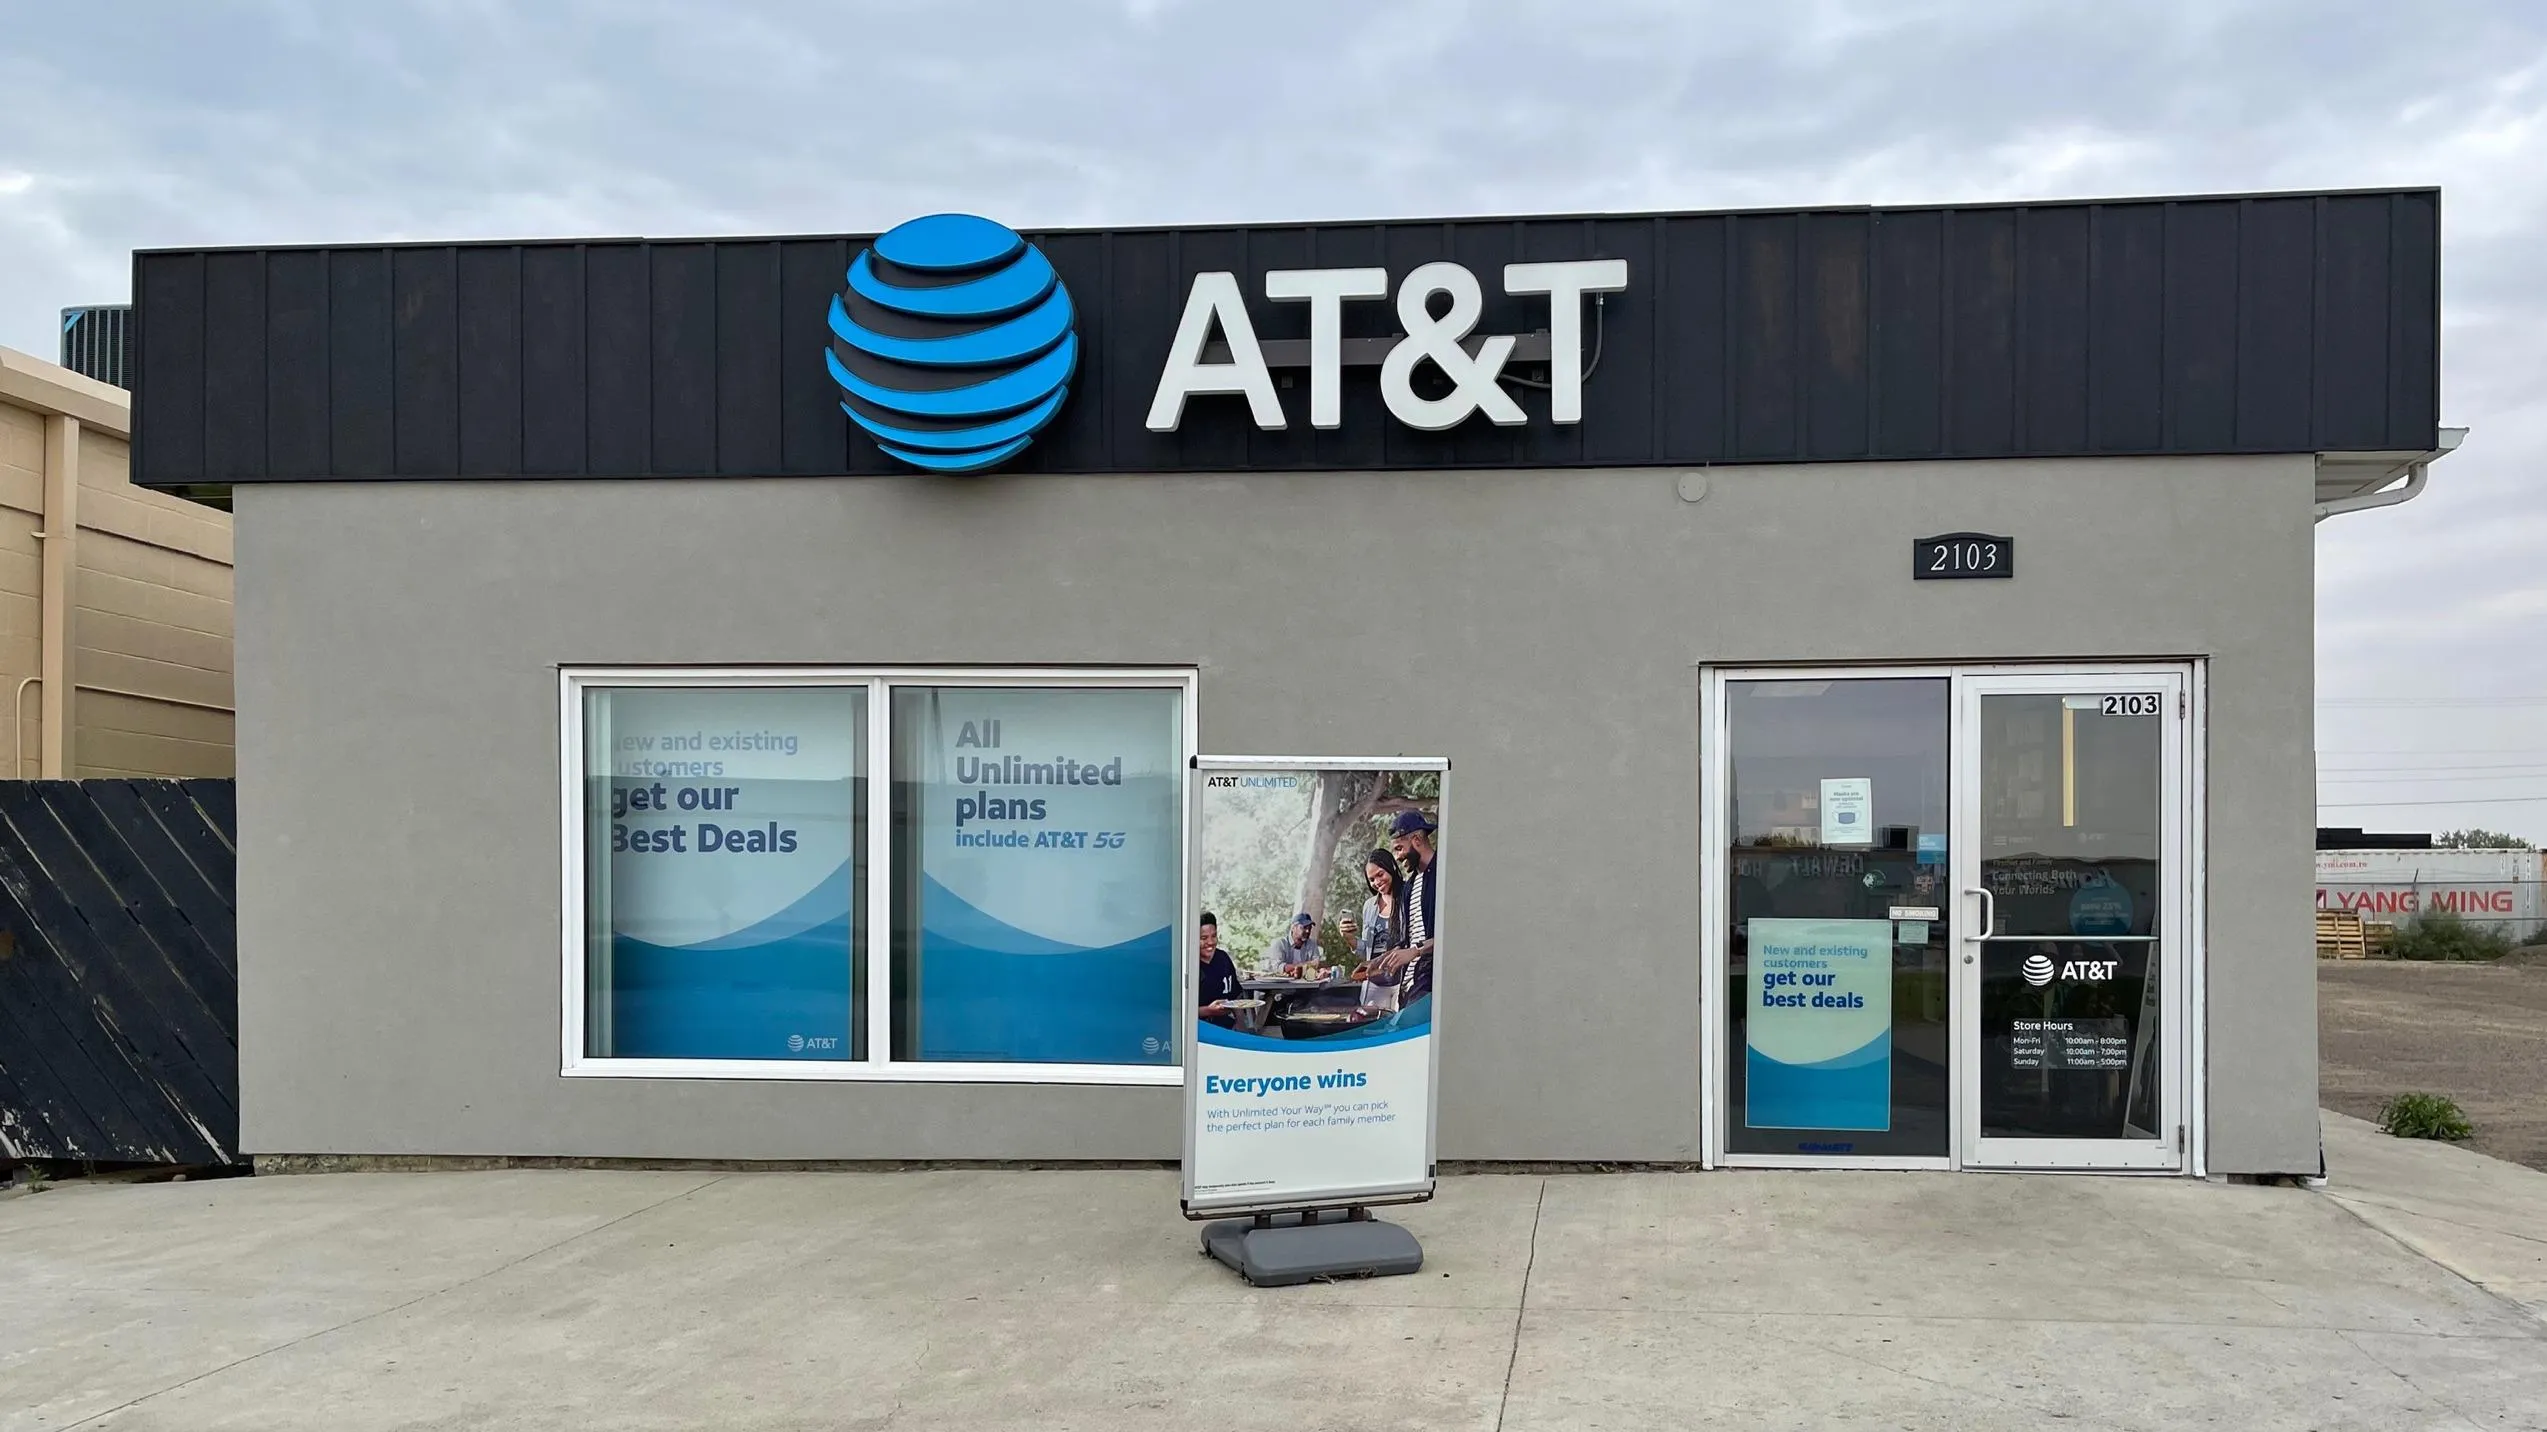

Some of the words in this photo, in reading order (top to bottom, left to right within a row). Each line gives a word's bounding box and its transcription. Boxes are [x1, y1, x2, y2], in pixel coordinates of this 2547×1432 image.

[1145, 259, 1628, 432] AT&T
[1930, 543, 1997, 571] 2103
[2104, 695, 2157, 715] 2103
[955, 719, 1001, 748] All
[661, 731, 702, 751] and
[709, 731, 798, 756] existing
[617, 758, 724, 777] ustomers
[956, 755, 1122, 786] Unlimited
[1208, 777, 1238, 788] AT&T
[1240, 777, 1298, 788] UNLIMITED
[613, 783, 667, 818] get
[677, 787, 740, 811] our
[956, 790, 1047, 827] plans
[613, 823, 687, 853] Best
[698, 821, 798, 853] Deals
[956, 829, 1029, 848] include
[1034, 831, 1088, 849] AT&T
[1092, 832, 1126, 849] 5G
[1992, 870, 2049, 883] Connecting
[2051, 869, 2077, 880] Both
[2019, 884, 2055, 895] Worlds
[2337, 891, 2419, 913] YANG
[2431, 891, 2513, 913] MING
[1763, 945, 1790, 956] New
[1793, 945, 1817, 956] and
[1819, 944, 1868, 959] existing
[1763, 958, 1828, 969] customers
[2060, 960, 2118, 981] AT&T
[1763, 971, 1797, 990] get
[1802, 974, 1836, 987] our
[1762, 991, 1807, 1007] best
[1811, 992, 1864, 1009] deals
[2013, 1021, 2041, 1031] Store
[2043, 1021, 2074, 1031] Hours
[806, 1037, 838, 1049] AT&T
[2013, 1037, 2041, 1045] Mon-Fri
[2065, 1037, 2095, 1045] 10:00am
[2100, 1037, 2127, 1047] 8:00pm
[2013, 1047, 2045, 1056] Saturday
[2101, 1048, 2127, 1057] 7:00pm
[2013, 1058, 2039, 1067] Sunday
[2101, 1058, 2127, 1067] 5:00pm
[1206, 1074, 1312, 1098] Everyone
[1317, 1068, 1367, 1089] wins
[1207, 1108, 1230, 1119] With
[1232, 1107, 1278, 1118] Unlimited
[1281, 1105, 1302, 1115] Your
[1333, 1104, 1351, 1115] you
[1352, 1103, 1369, 1111] can
[1371, 1100, 1389, 1112] pick
[1207, 1123, 1224, 1133] the
[1226, 1121, 1262, 1133] perfect
[1264, 1120, 1285, 1132] plan
[1287, 1119, 1301, 1128] for
[1302, 1118, 1325, 1127] each
[1327, 1116, 1356, 1127] family
[1357, 1113, 1396, 1124] member
